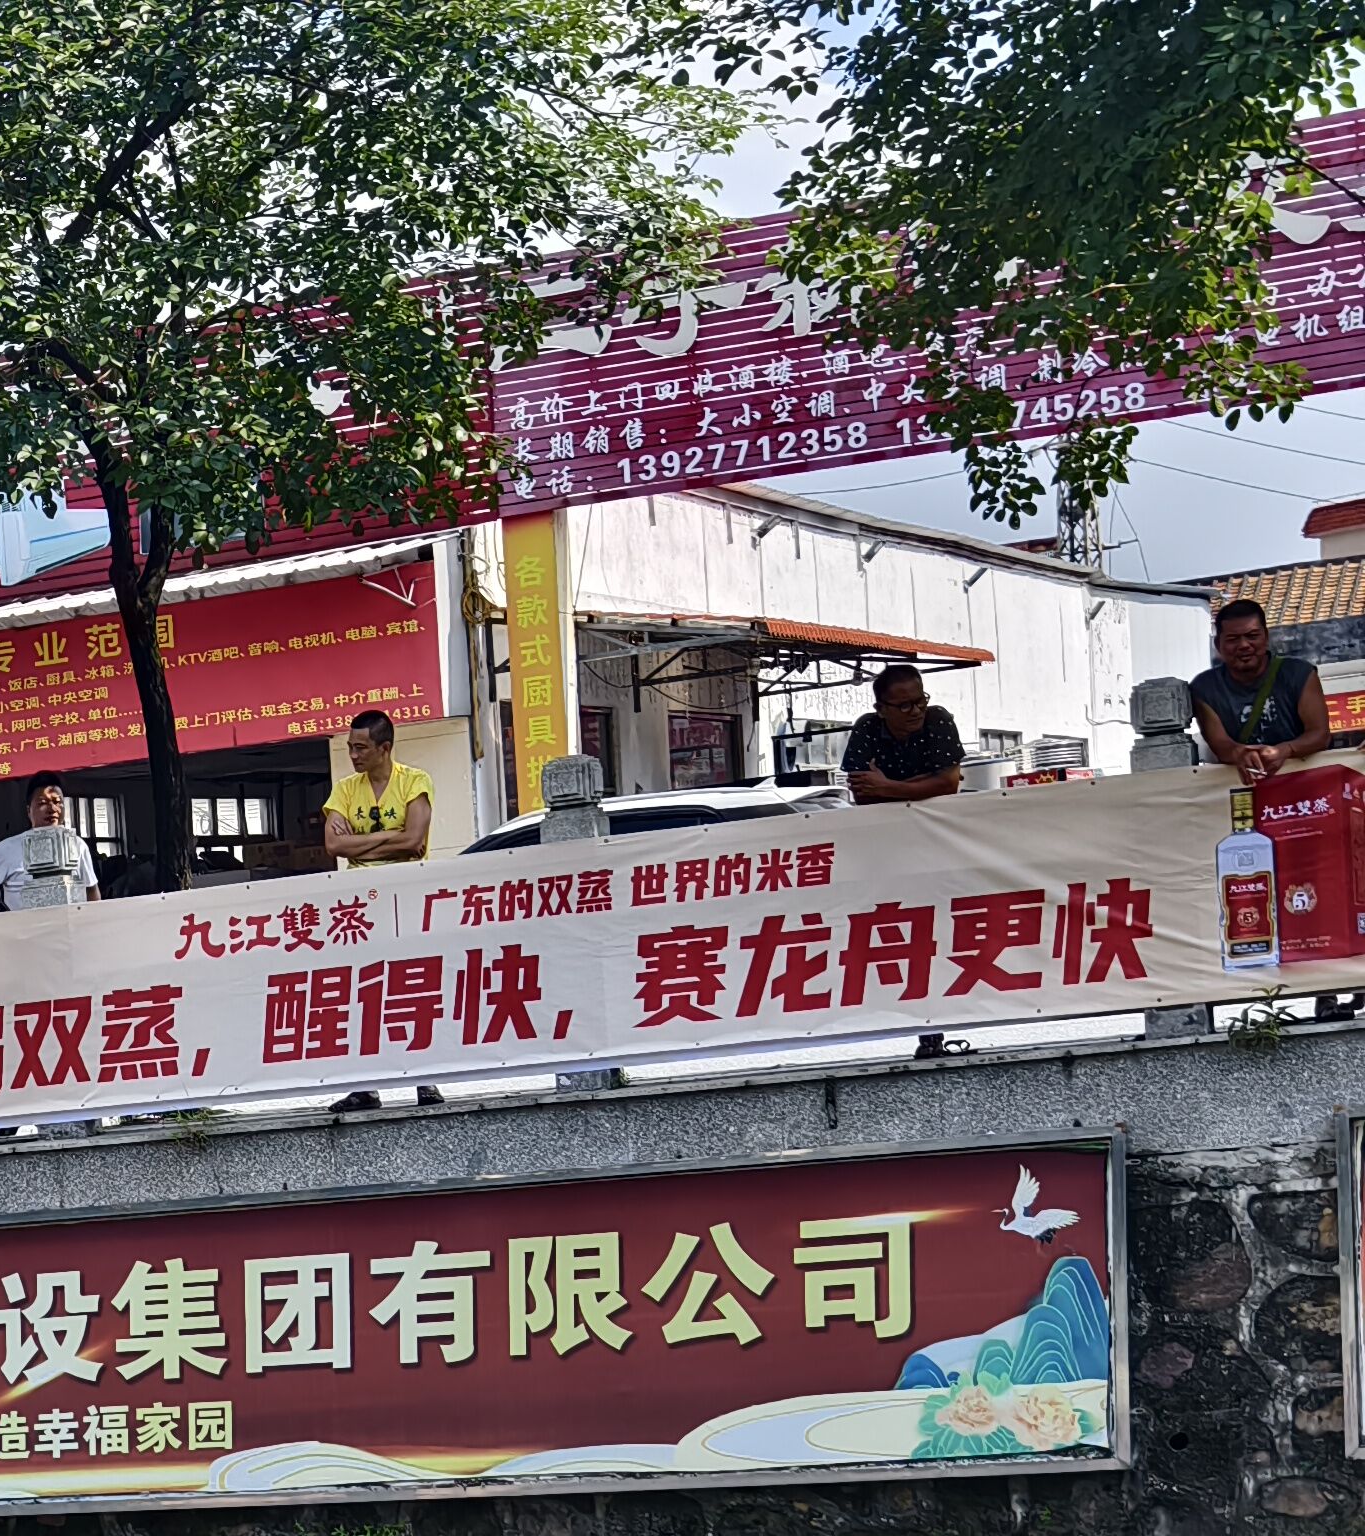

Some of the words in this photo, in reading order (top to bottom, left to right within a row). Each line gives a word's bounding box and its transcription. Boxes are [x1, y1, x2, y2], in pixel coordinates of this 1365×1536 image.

[617, 421, 867, 484] 13927712358
[421, 869, 614, 932] 广东的双蒸
[630, 842, 836, 907] 世界的米香
